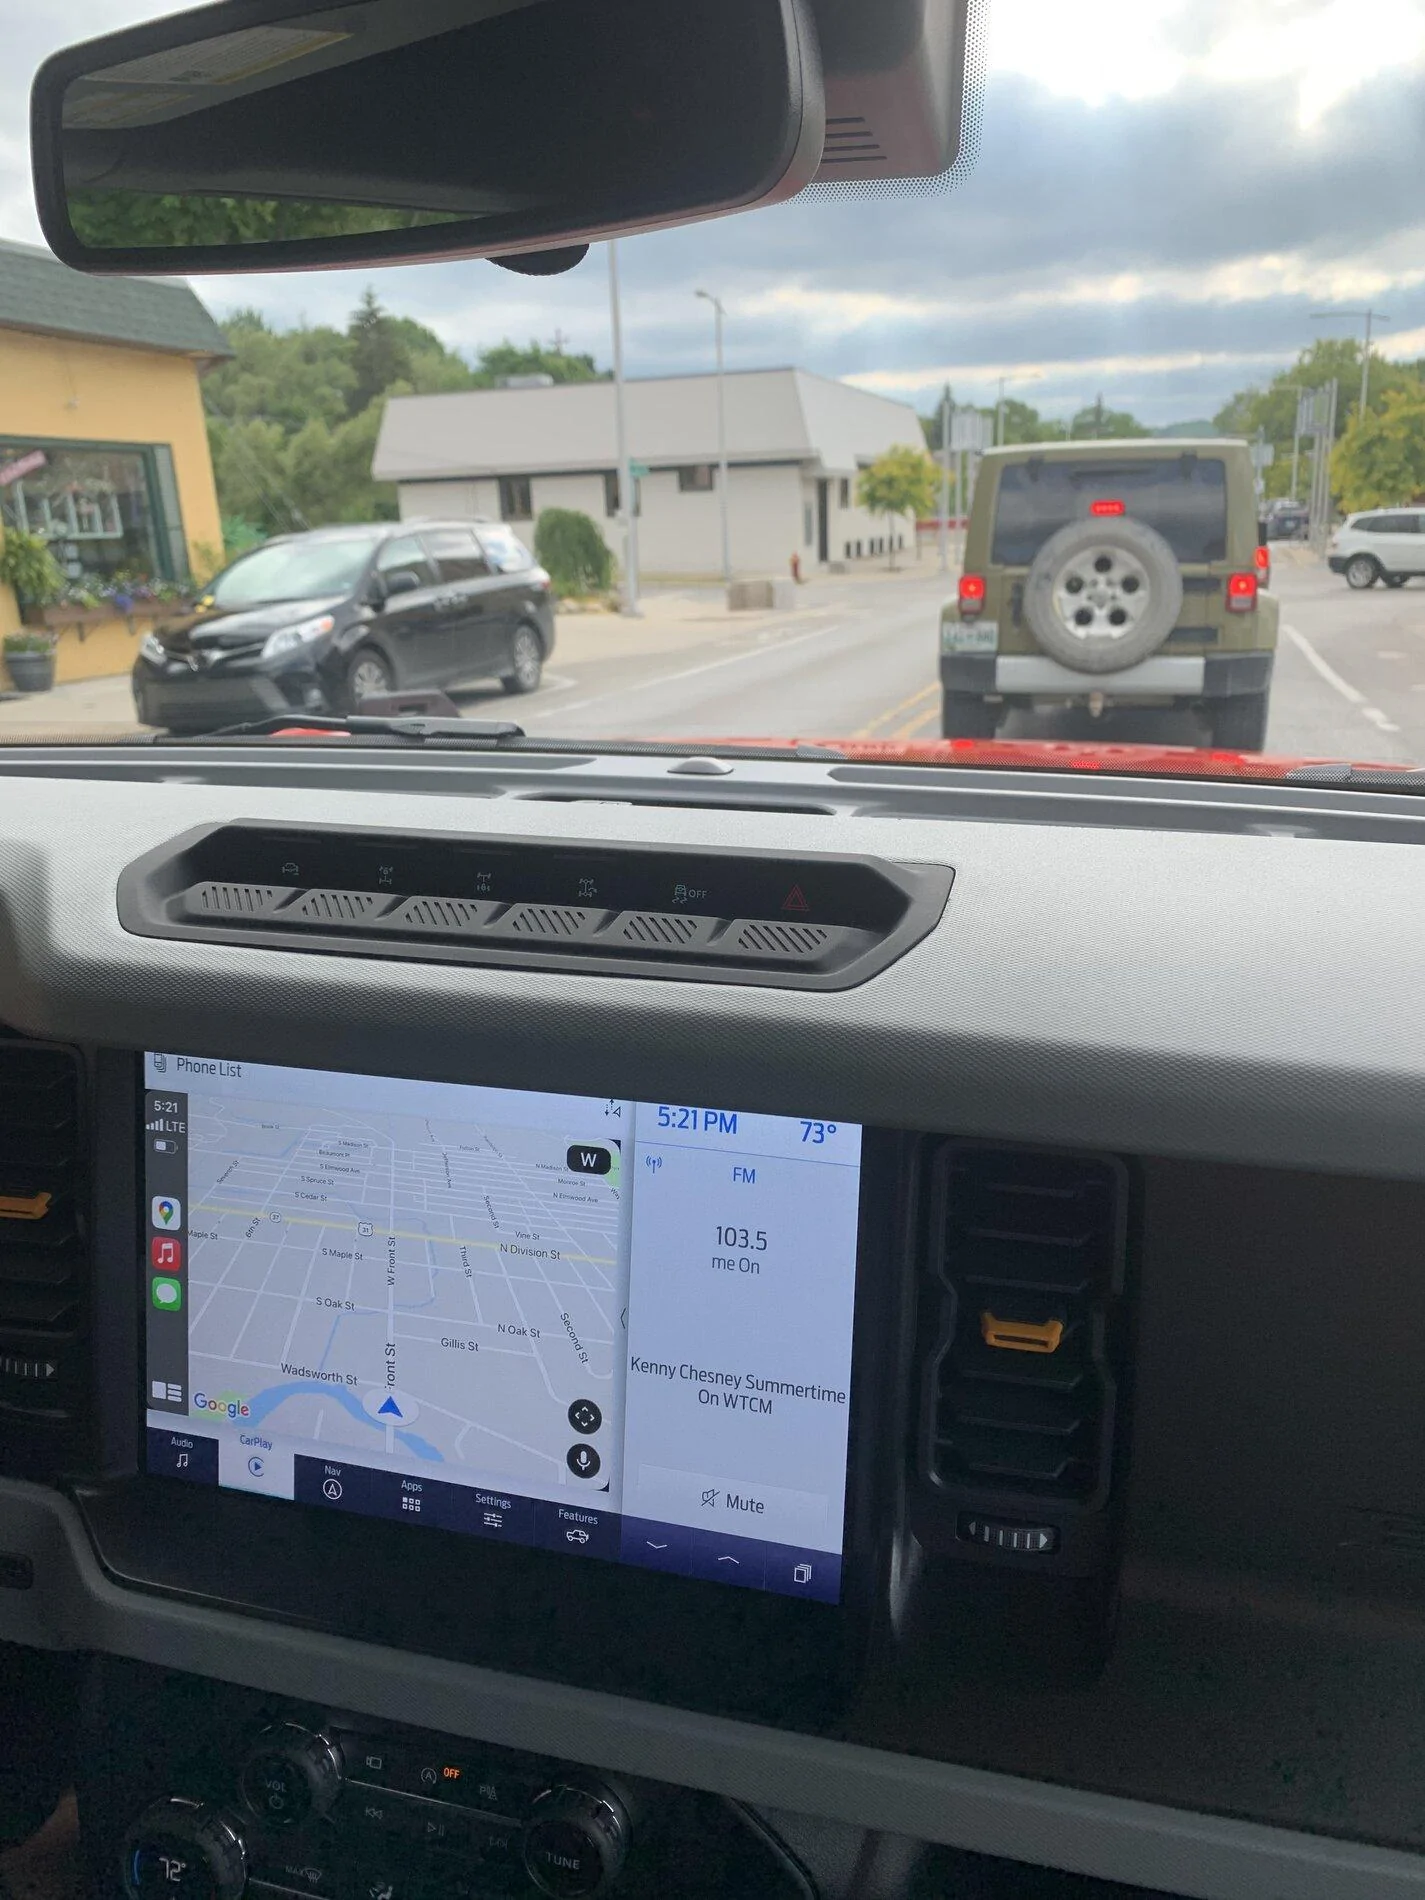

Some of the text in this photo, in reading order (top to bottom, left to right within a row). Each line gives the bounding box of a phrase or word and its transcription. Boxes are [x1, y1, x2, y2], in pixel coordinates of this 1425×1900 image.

[688, 889, 708, 899] OFF
[177, 1057, 242, 1078] Phone List
[154, 1100, 178, 1114] 5:21
[166, 1120, 186, 1134] LTE
[657, 1106, 738, 1134] 5:21 PM
[800, 1120, 837, 1144] 73°
[580, 1152, 597, 1168] W
[306, 1176, 326, 1186] Spruce
[733, 1166, 756, 1184] FM
[300, 1192, 320, 1201] Cedar
[560, 1193, 586, 1202] Elmwood
[484, 1196, 500, 1229] Second St
[210, 1232, 218, 1240] St
[246, 1217, 261, 1238] 6th St
[515, 1231, 540, 1241] Vine St
[716, 1226, 768, 1251] 103.5
[322, 1248, 364, 1261] S Maple St
[500, 1244, 561, 1260] N Division St
[387, 1236, 396, 1286] W Front St
[460, 1246, 473, 1279] Third St
[712, 1257, 760, 1275] me On
[316, 1297, 355, 1311] S Oak St
[498, 1324, 541, 1338] N Oak St
[560, 1312, 589, 1364] Second St
[441, 1338, 479, 1352] Gillis St
[280, 1363, 358, 1386] Wadsworth St
[385, 1342, 396, 1390] ront St
[630, 1356, 846, 1404] Kenny Chesney Summertime
[194, 1392, 250, 1418] Google
[698, 1388, 773, 1415] On WTCM
[170, 1436, 194, 1450] Audio
[240, 1434, 273, 1451] CarPlay
[324, 1465, 342, 1477] Nav
[400, 1480, 423, 1493] Apps
[476, 1493, 512, 1510] Settings
[726, 1493, 765, 1514] Mute
[558, 1508, 599, 1526] Features
[443, 1768, 460, 1780] OFF
[265, 1778, 287, 1793] VOL
[158, 1856, 187, 1882] 72°
[546, 1852, 581, 1870] TUNE
